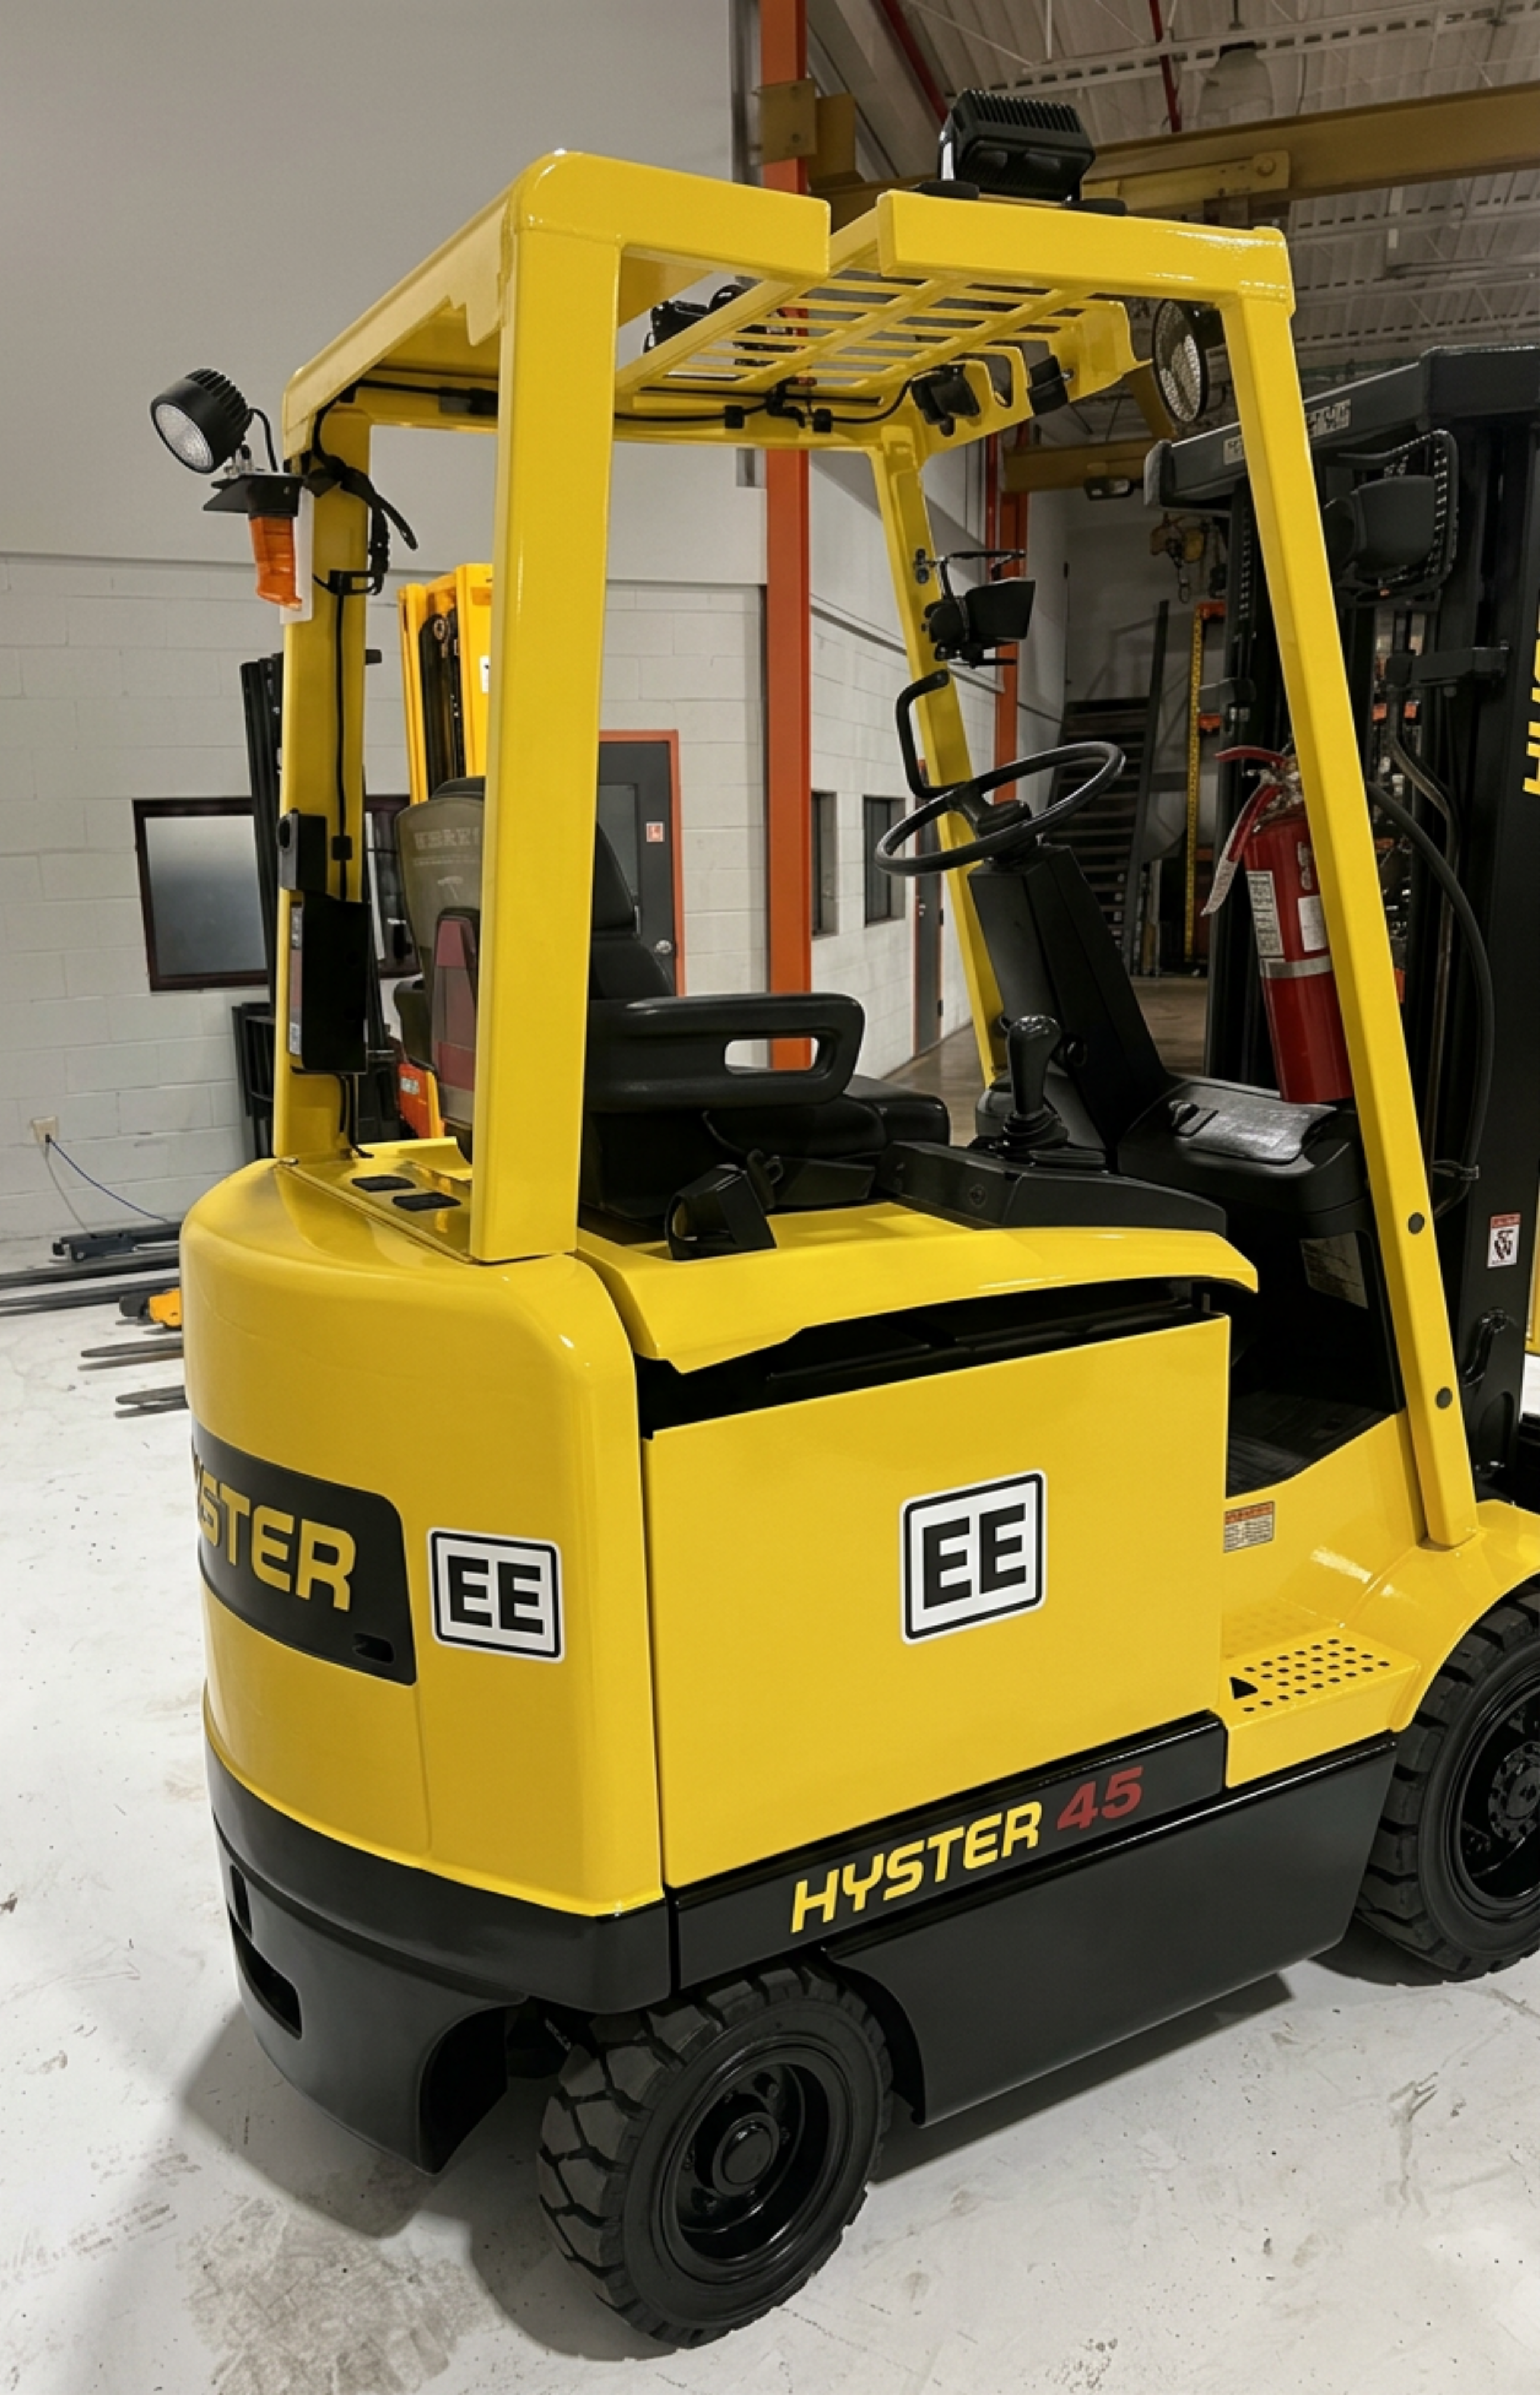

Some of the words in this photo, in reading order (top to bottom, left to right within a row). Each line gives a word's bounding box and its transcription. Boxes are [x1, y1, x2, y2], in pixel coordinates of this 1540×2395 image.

[194, 1455, 356, 1612] STER
[447, 1554, 544, 1635] EE
[922, 1502, 1026, 1610] EE
[790, 1800, 1043, 1933] HYSTER
[1056, 1765, 1144, 1831] 45
